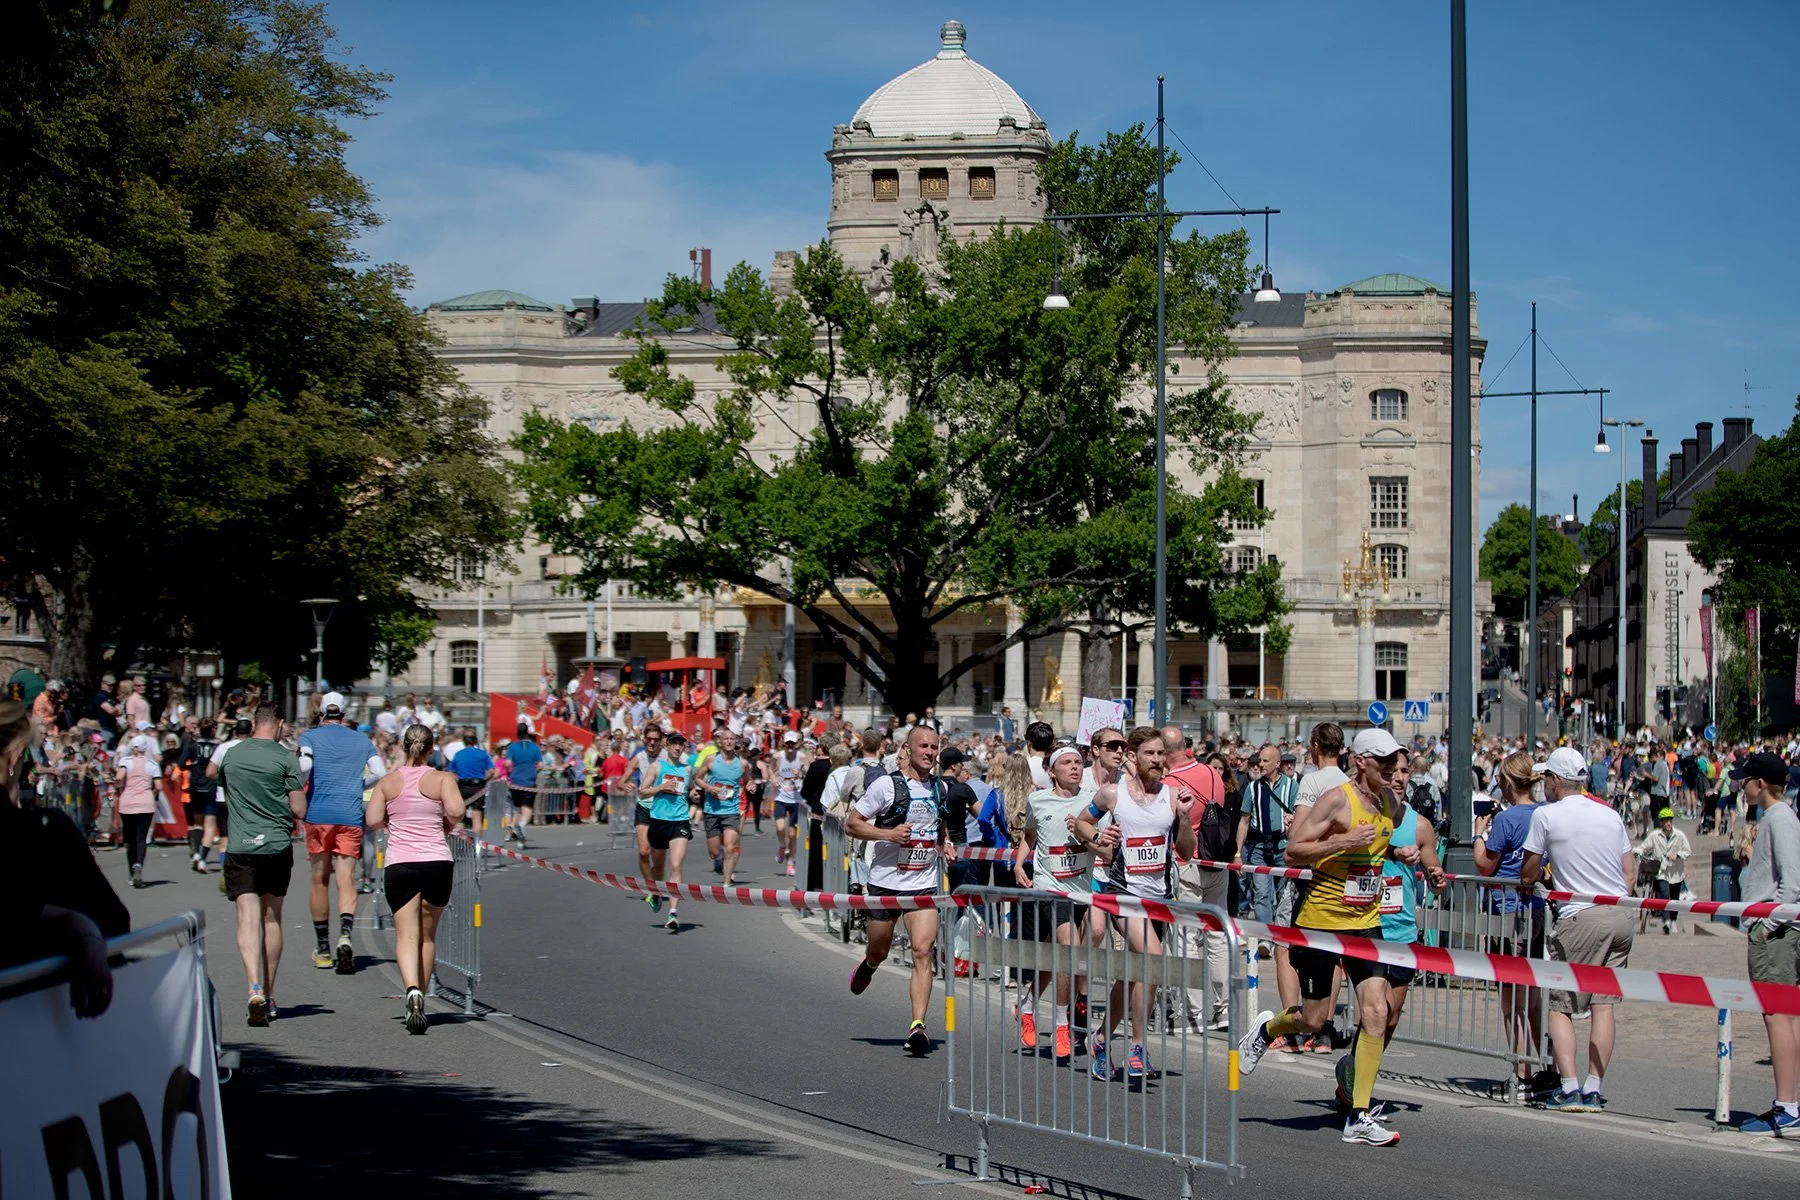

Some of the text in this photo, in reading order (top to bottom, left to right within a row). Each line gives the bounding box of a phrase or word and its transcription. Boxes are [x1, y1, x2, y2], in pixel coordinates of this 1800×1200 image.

[907, 849, 929, 861] 2302
[1137, 848, 1159, 861] 1036
[1060, 855, 1077, 868] 1127
[1358, 878, 1376, 892] 1516
